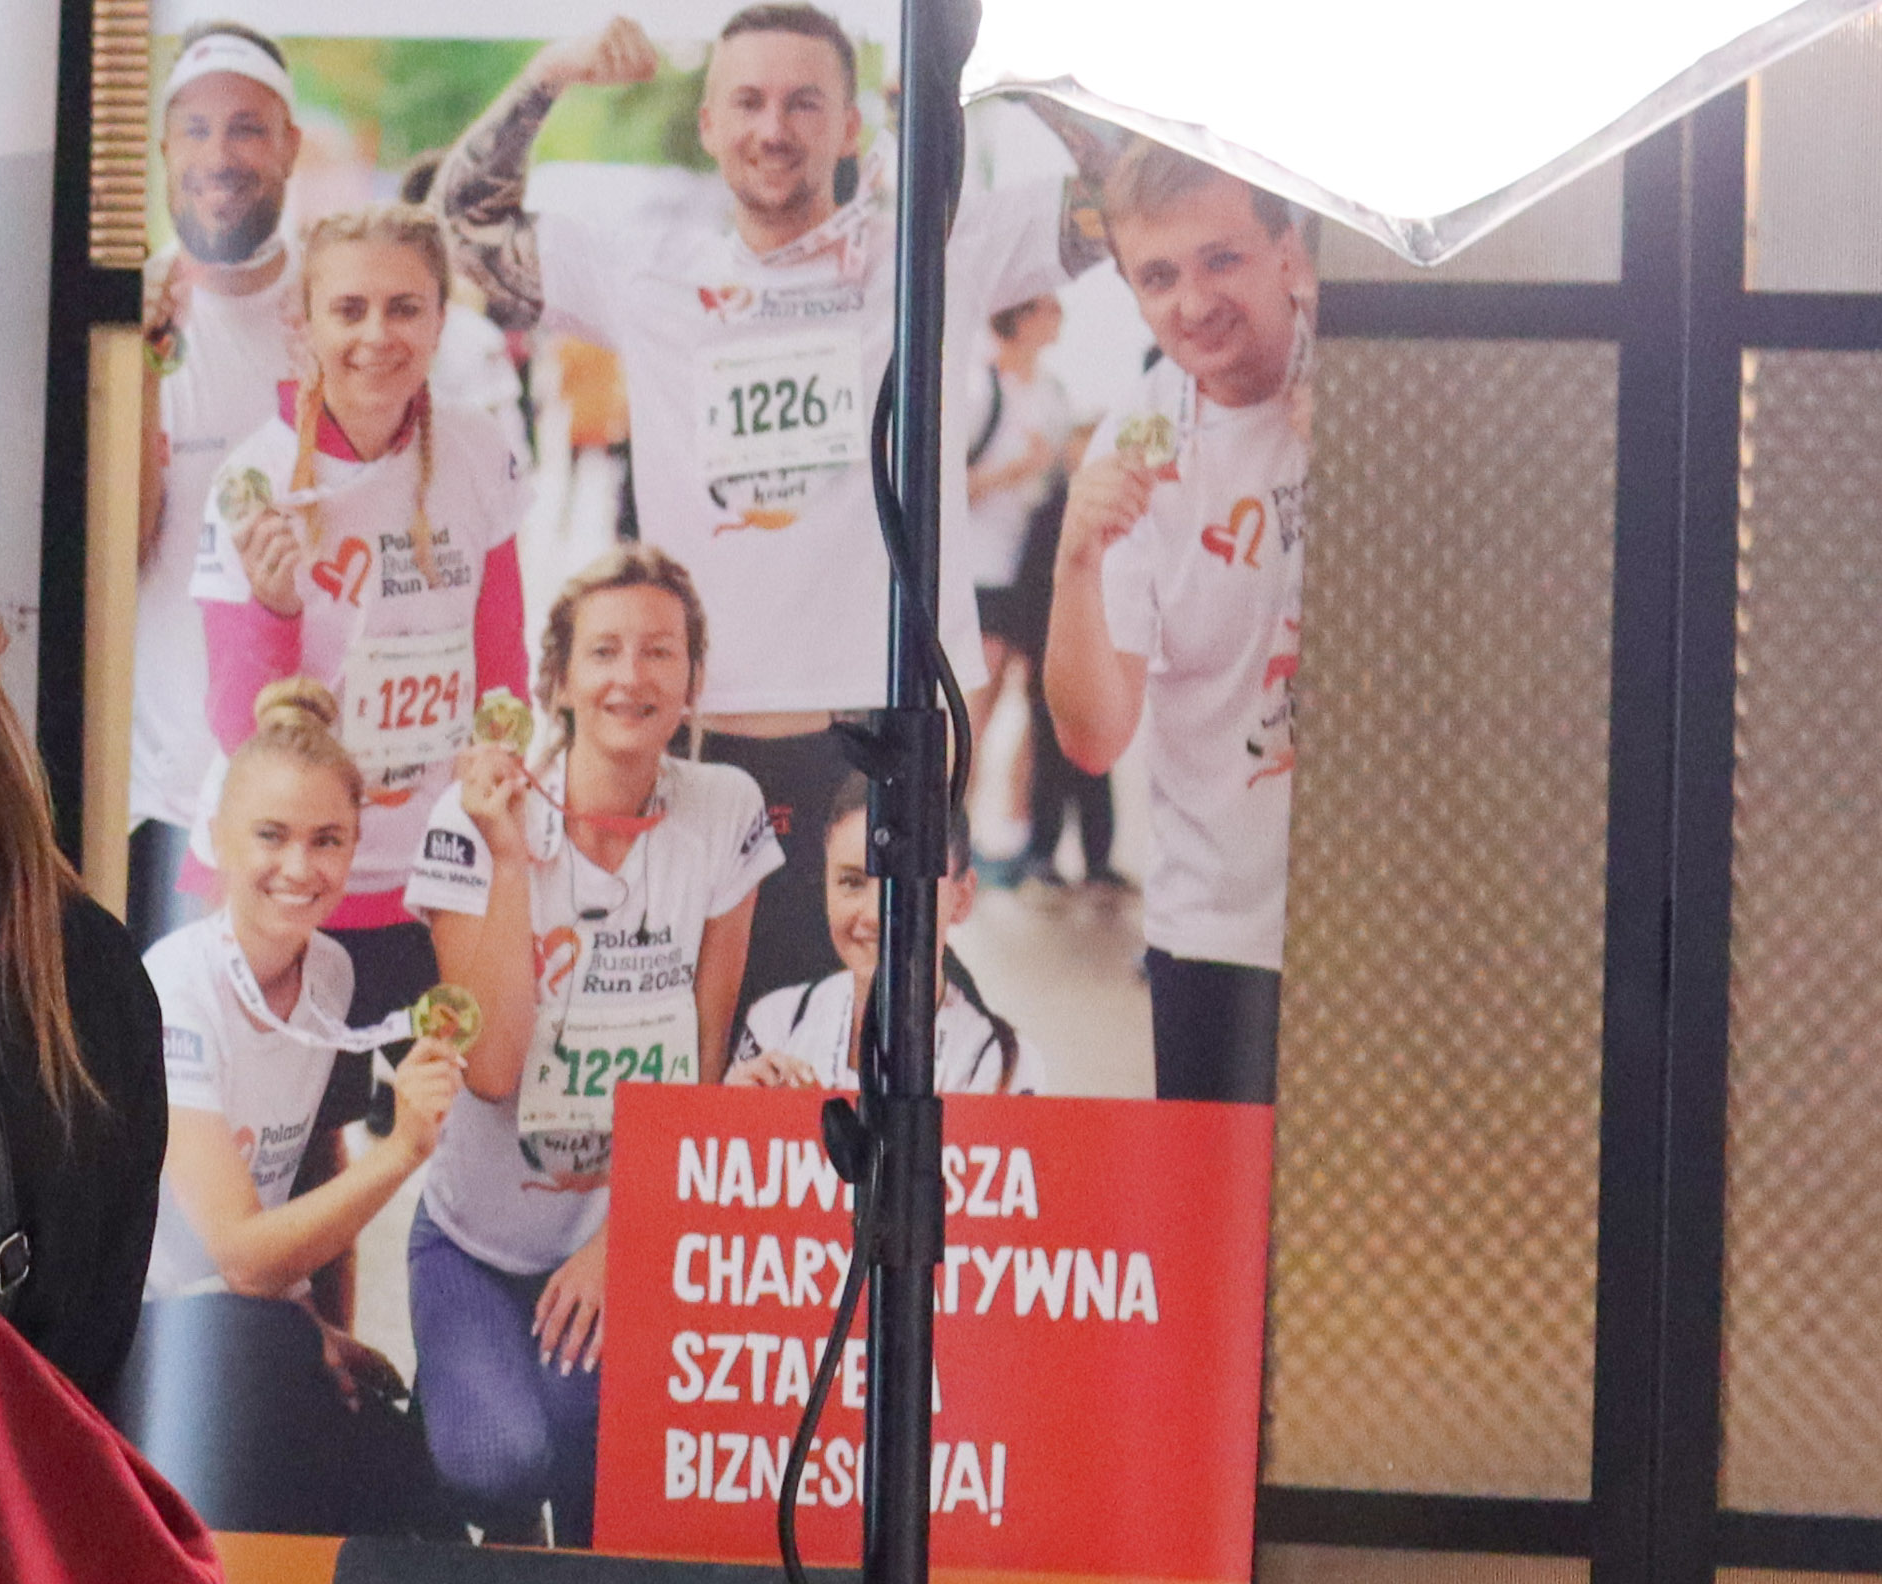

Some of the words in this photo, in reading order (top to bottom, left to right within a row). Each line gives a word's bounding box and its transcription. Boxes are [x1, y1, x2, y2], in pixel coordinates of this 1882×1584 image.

[378, 671, 461, 730] 1224
[582, 974, 632, 994] Run
[639, 963, 696, 993] 2023
[673, 1233, 1159, 1324] CHARYTYWNA
